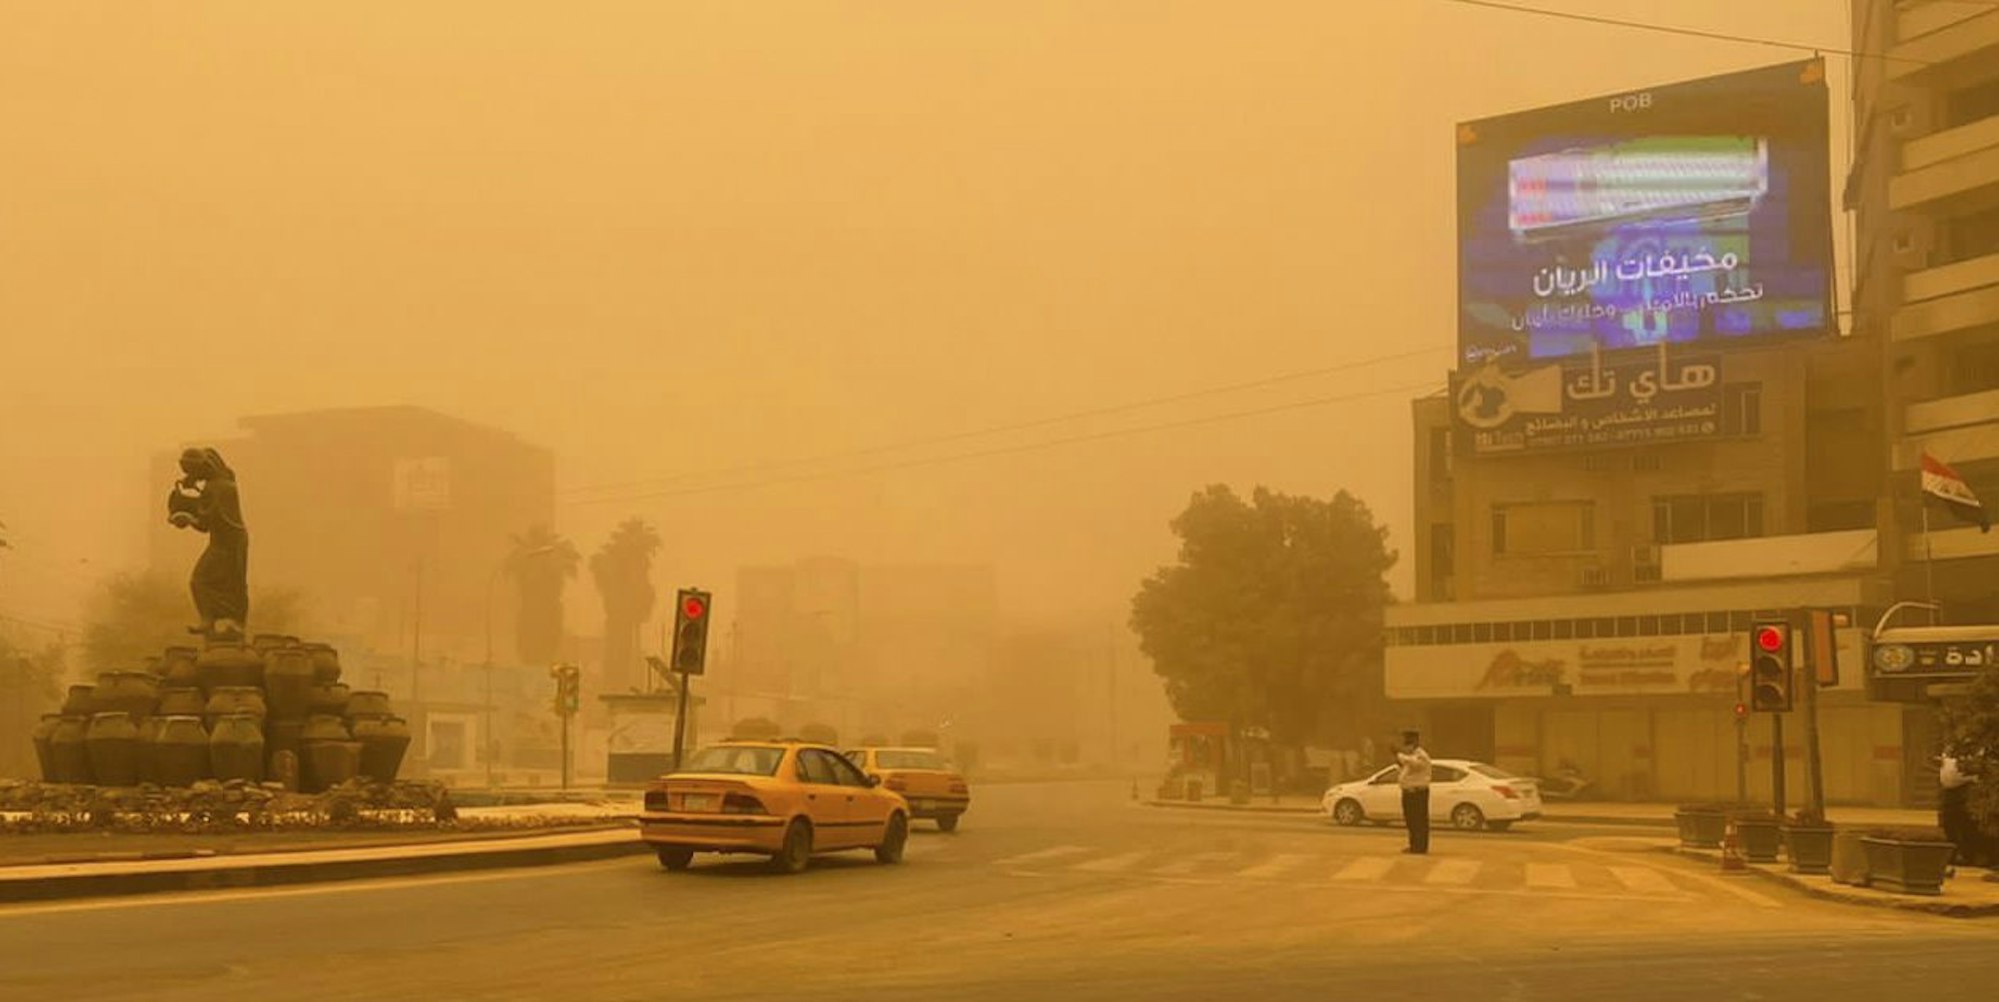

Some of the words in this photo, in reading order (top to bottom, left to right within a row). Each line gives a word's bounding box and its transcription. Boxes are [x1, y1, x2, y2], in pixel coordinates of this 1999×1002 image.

[1533, 260, 1607, 297] الريان
[1567, 343, 1616, 400] تك
[1629, 342, 1715, 404] هاي
